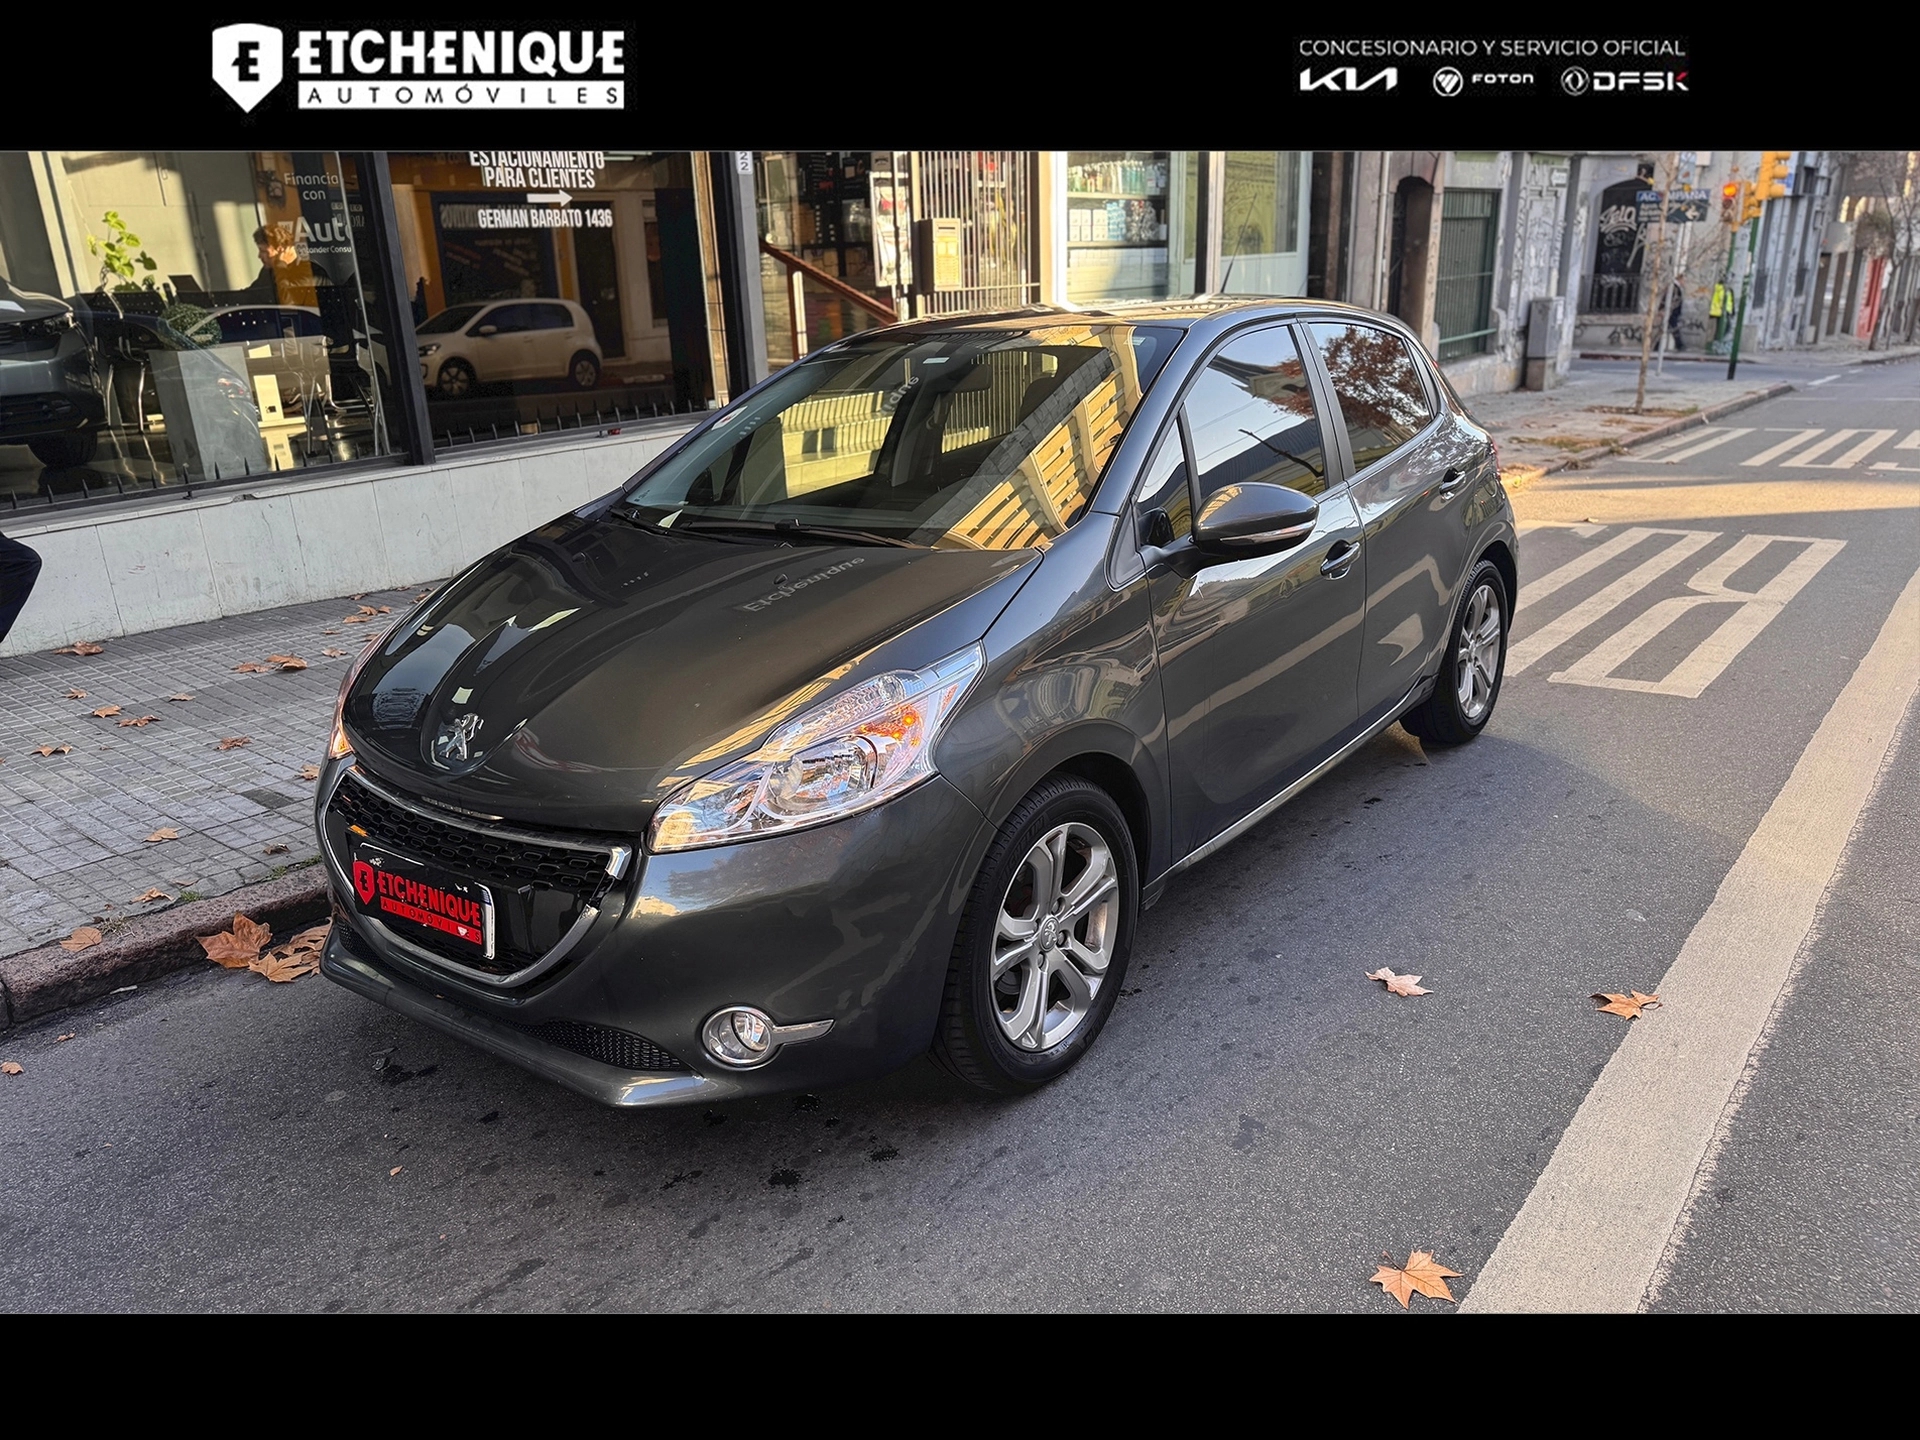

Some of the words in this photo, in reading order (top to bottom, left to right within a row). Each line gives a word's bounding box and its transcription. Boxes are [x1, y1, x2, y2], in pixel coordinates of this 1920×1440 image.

[469, 151, 605, 169] ESTACIONAMIENTO
[284, 172, 339, 185] Financia
[485, 167, 526, 188] PARA
[529, 168, 596, 188] CLIENTES
[302, 190, 327, 200] con
[478, 209, 529, 228] GERMAN
[530, 209, 583, 228] BARBATO
[585, 209, 613, 228] 1436
[1503, 520, 1848, 698] BU
